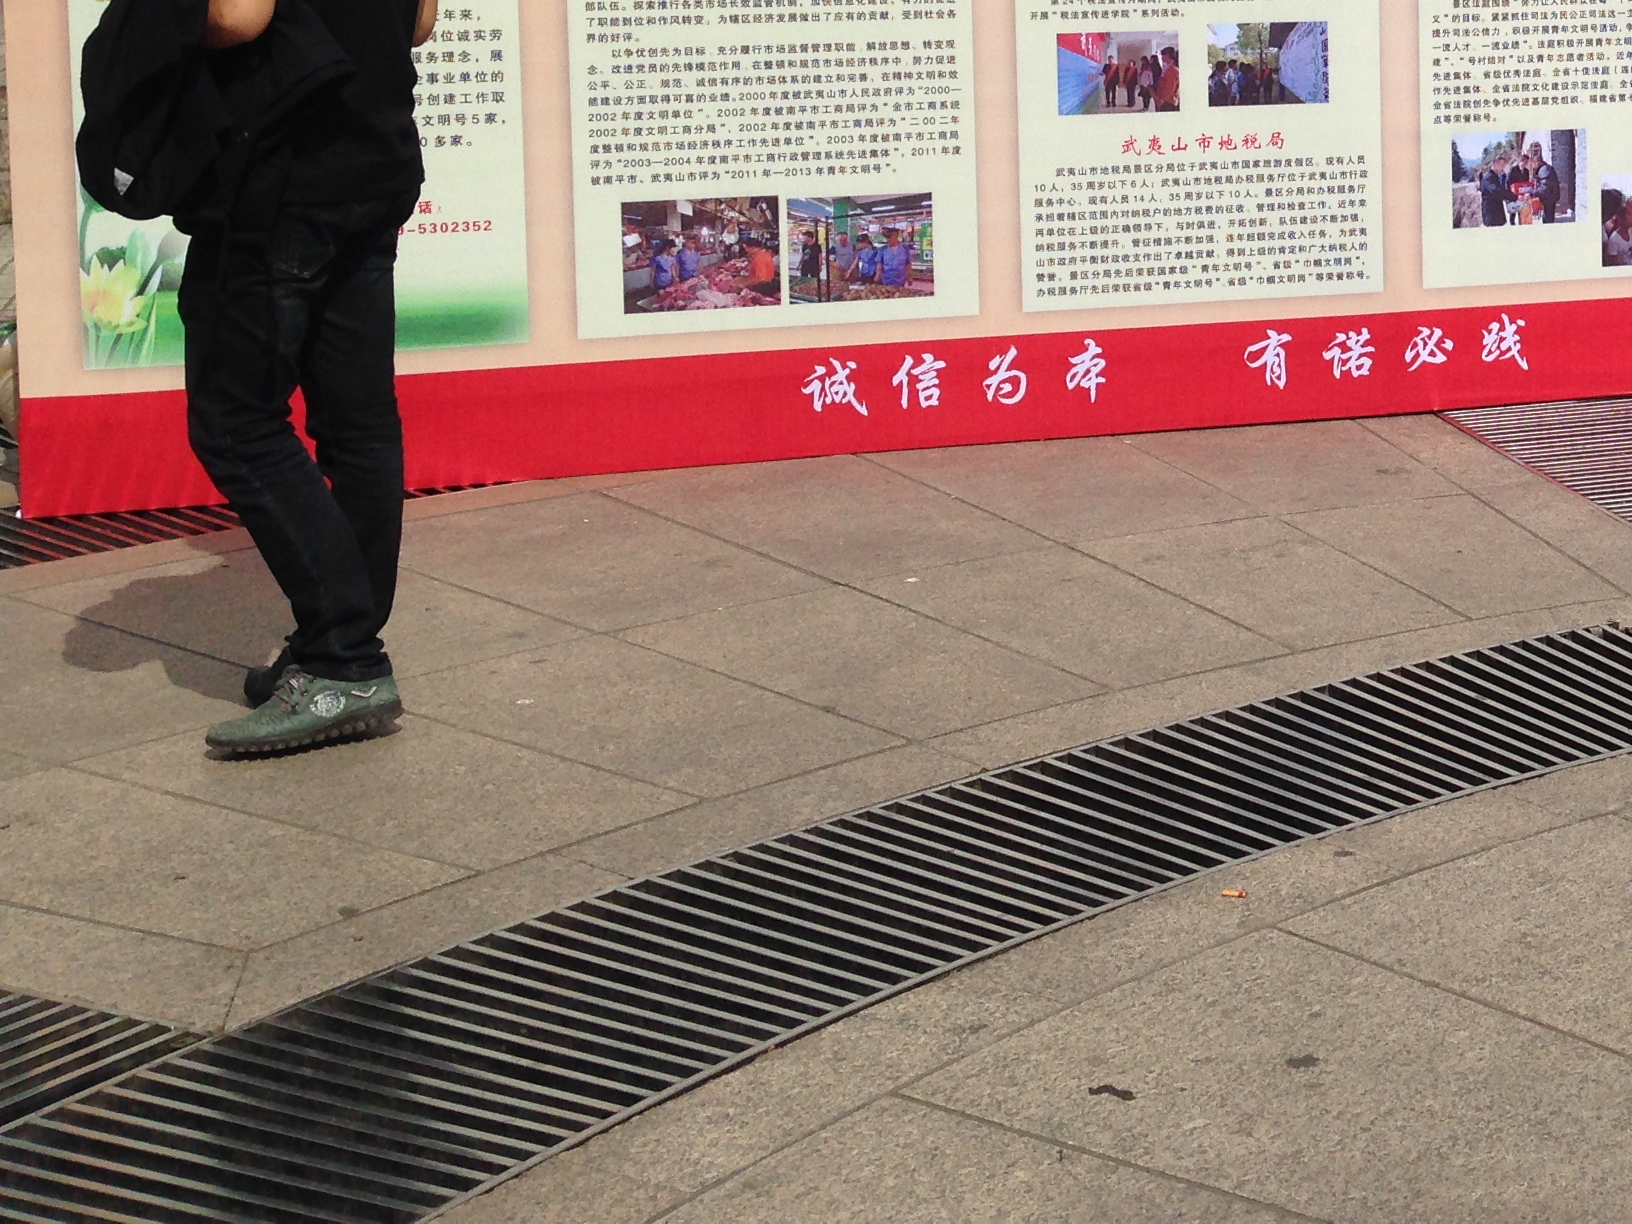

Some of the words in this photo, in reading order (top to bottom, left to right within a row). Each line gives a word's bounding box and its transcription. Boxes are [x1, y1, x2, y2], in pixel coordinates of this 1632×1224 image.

[1121, 131, 1287, 156] 武夷山市地税局
[802, 338, 1107, 417] 诚信为本
[1245, 313, 1531, 387] 有诺必践
